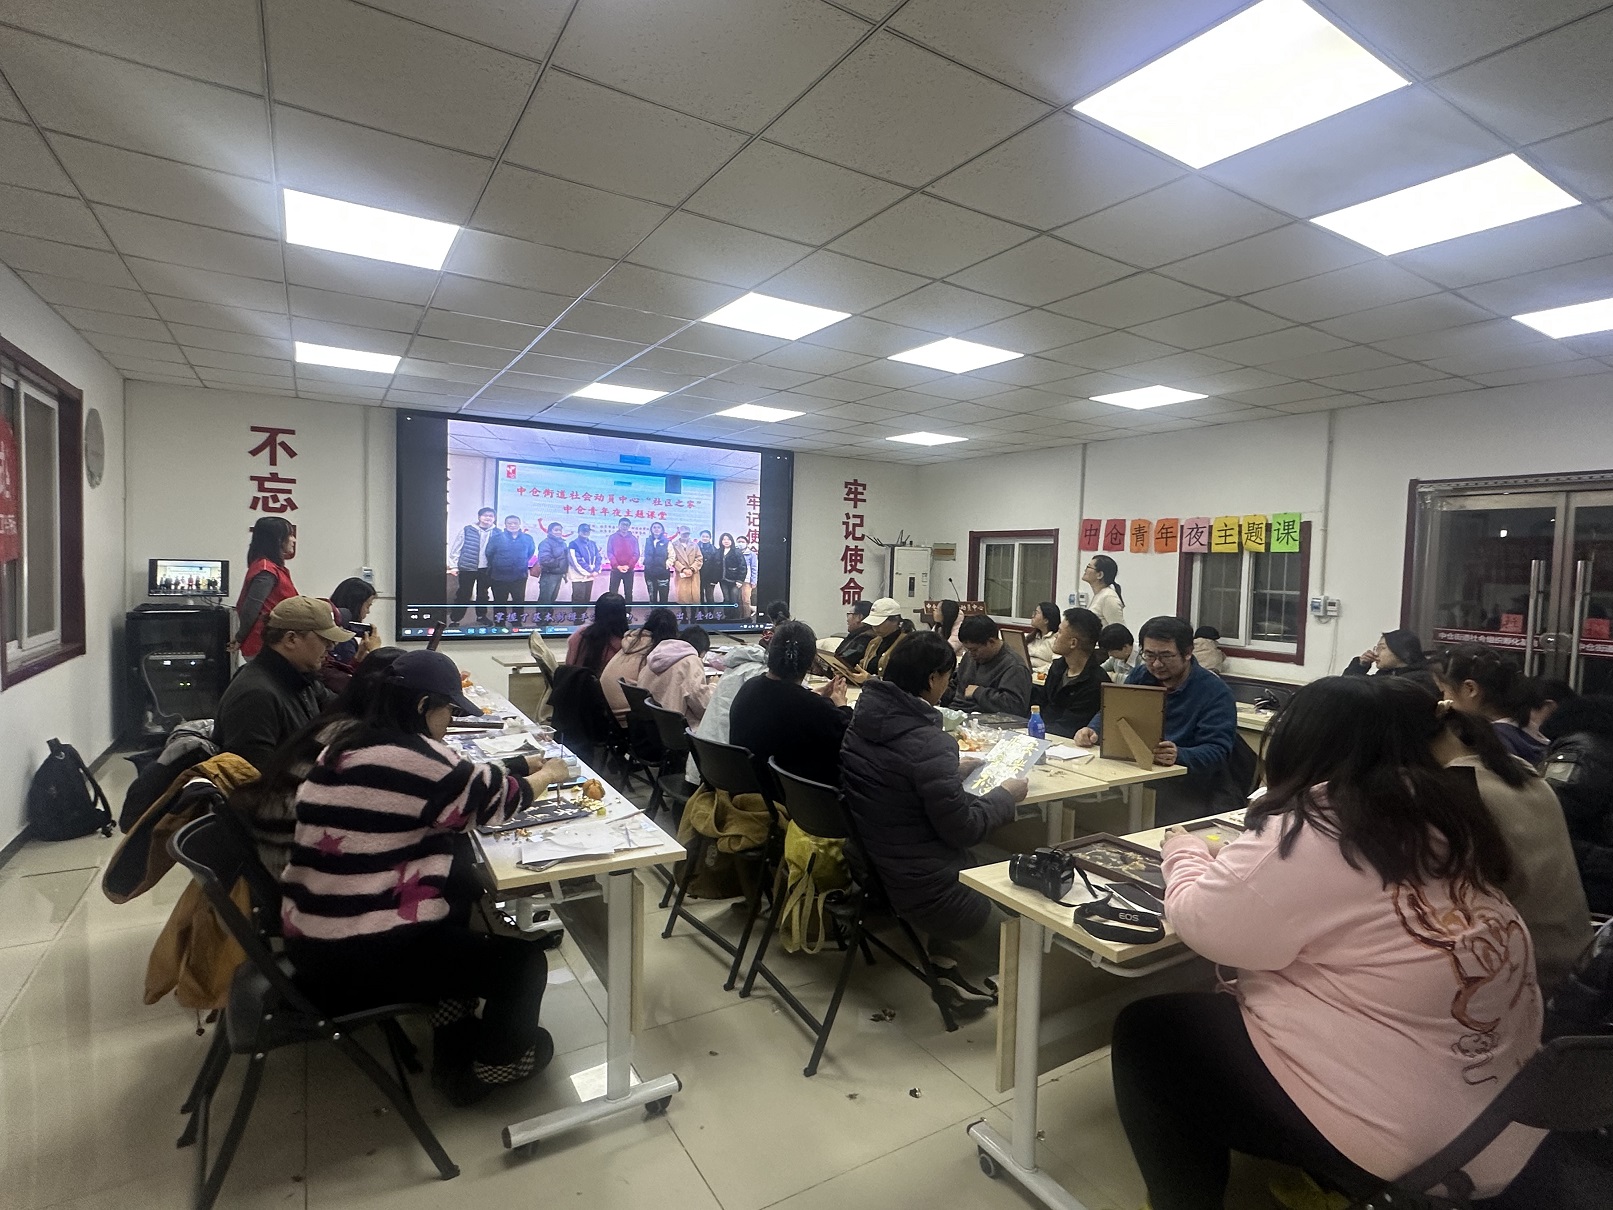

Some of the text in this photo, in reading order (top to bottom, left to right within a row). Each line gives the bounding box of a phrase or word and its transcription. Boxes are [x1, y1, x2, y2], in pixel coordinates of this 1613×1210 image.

[563, 504, 668, 520] 中仓青年夜主题课堂
[840, 479, 867, 606] 牢记使命
[1084, 519, 1299, 549] 中仓青年夜主题课
[1118, 912, 1139, 922] EOS
